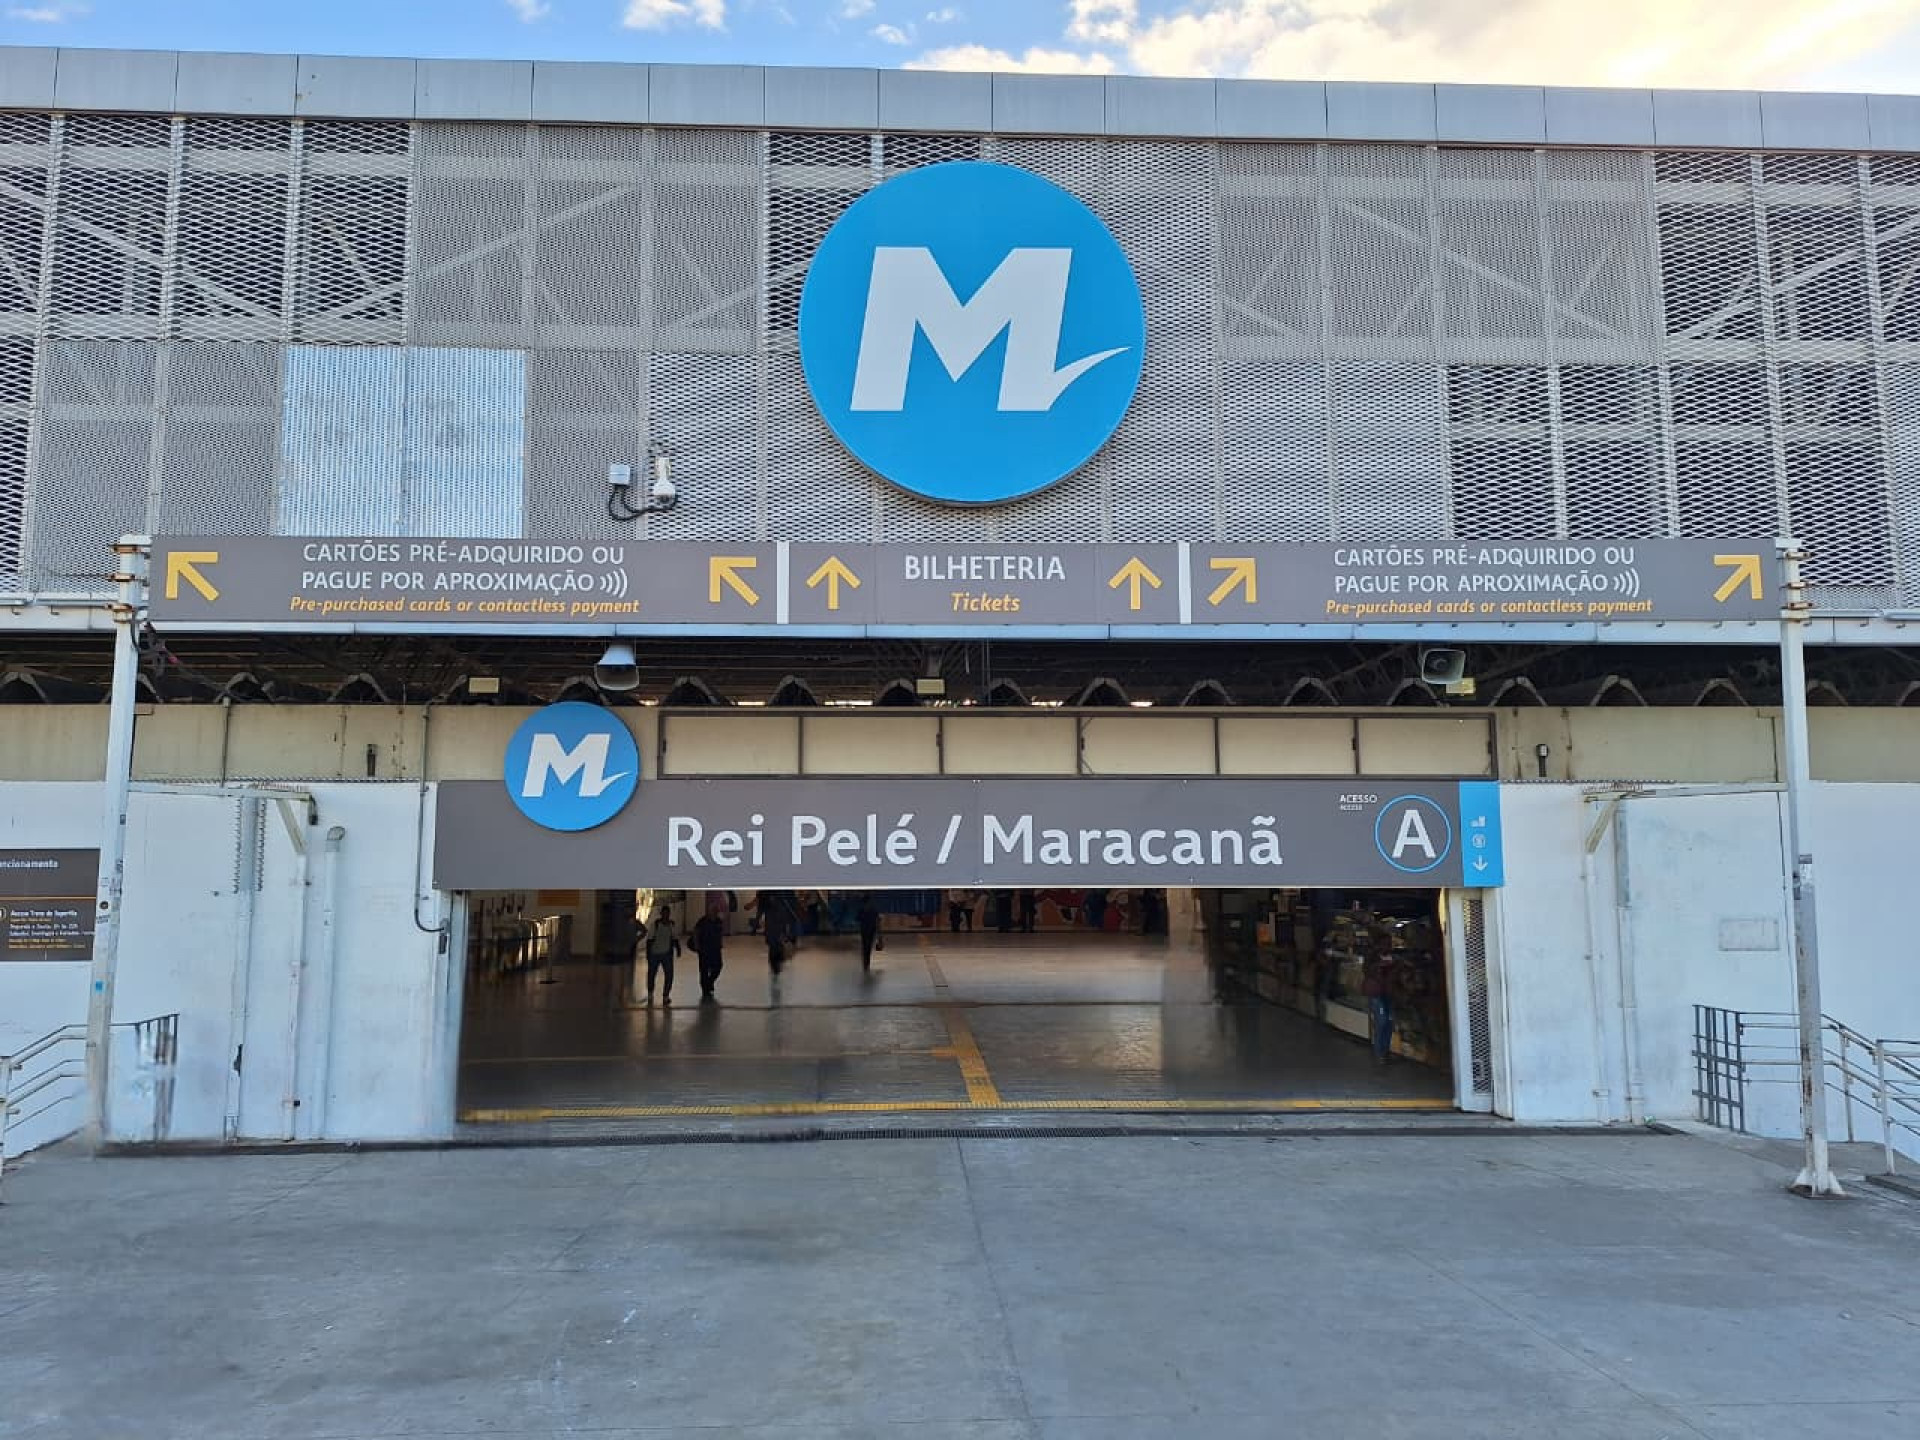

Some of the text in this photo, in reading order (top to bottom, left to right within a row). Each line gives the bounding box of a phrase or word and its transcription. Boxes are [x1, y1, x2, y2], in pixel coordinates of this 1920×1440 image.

[850, 246, 1132, 411] M
[303, 539, 624, 565] CARTÕES PRÉ-ADQUIRIDO OU
[1334, 544, 1635, 567] CARTÕES PRÉ-ADQUIRIDO OU
[904, 555, 1066, 580] BILHETERIA
[302, 570, 594, 595] PAGUE POR APROXIMAÇÃO
[1335, 570, 1609, 596] PAGUE POR APROXIMAÇÃO
[290, 596, 640, 617] Pre-purchased cards or contactless payment
[951, 592, 1021, 612] Tickets
[1326, 599, 1653, 618] Pre-purchased cards or contactless payment
[522, 733, 632, 797] M
[1340, 794, 1378, 804] ACESSO
[668, 813, 1284, 866] Rei Pelé / Maracanã
[1391, 809, 1437, 859] A
